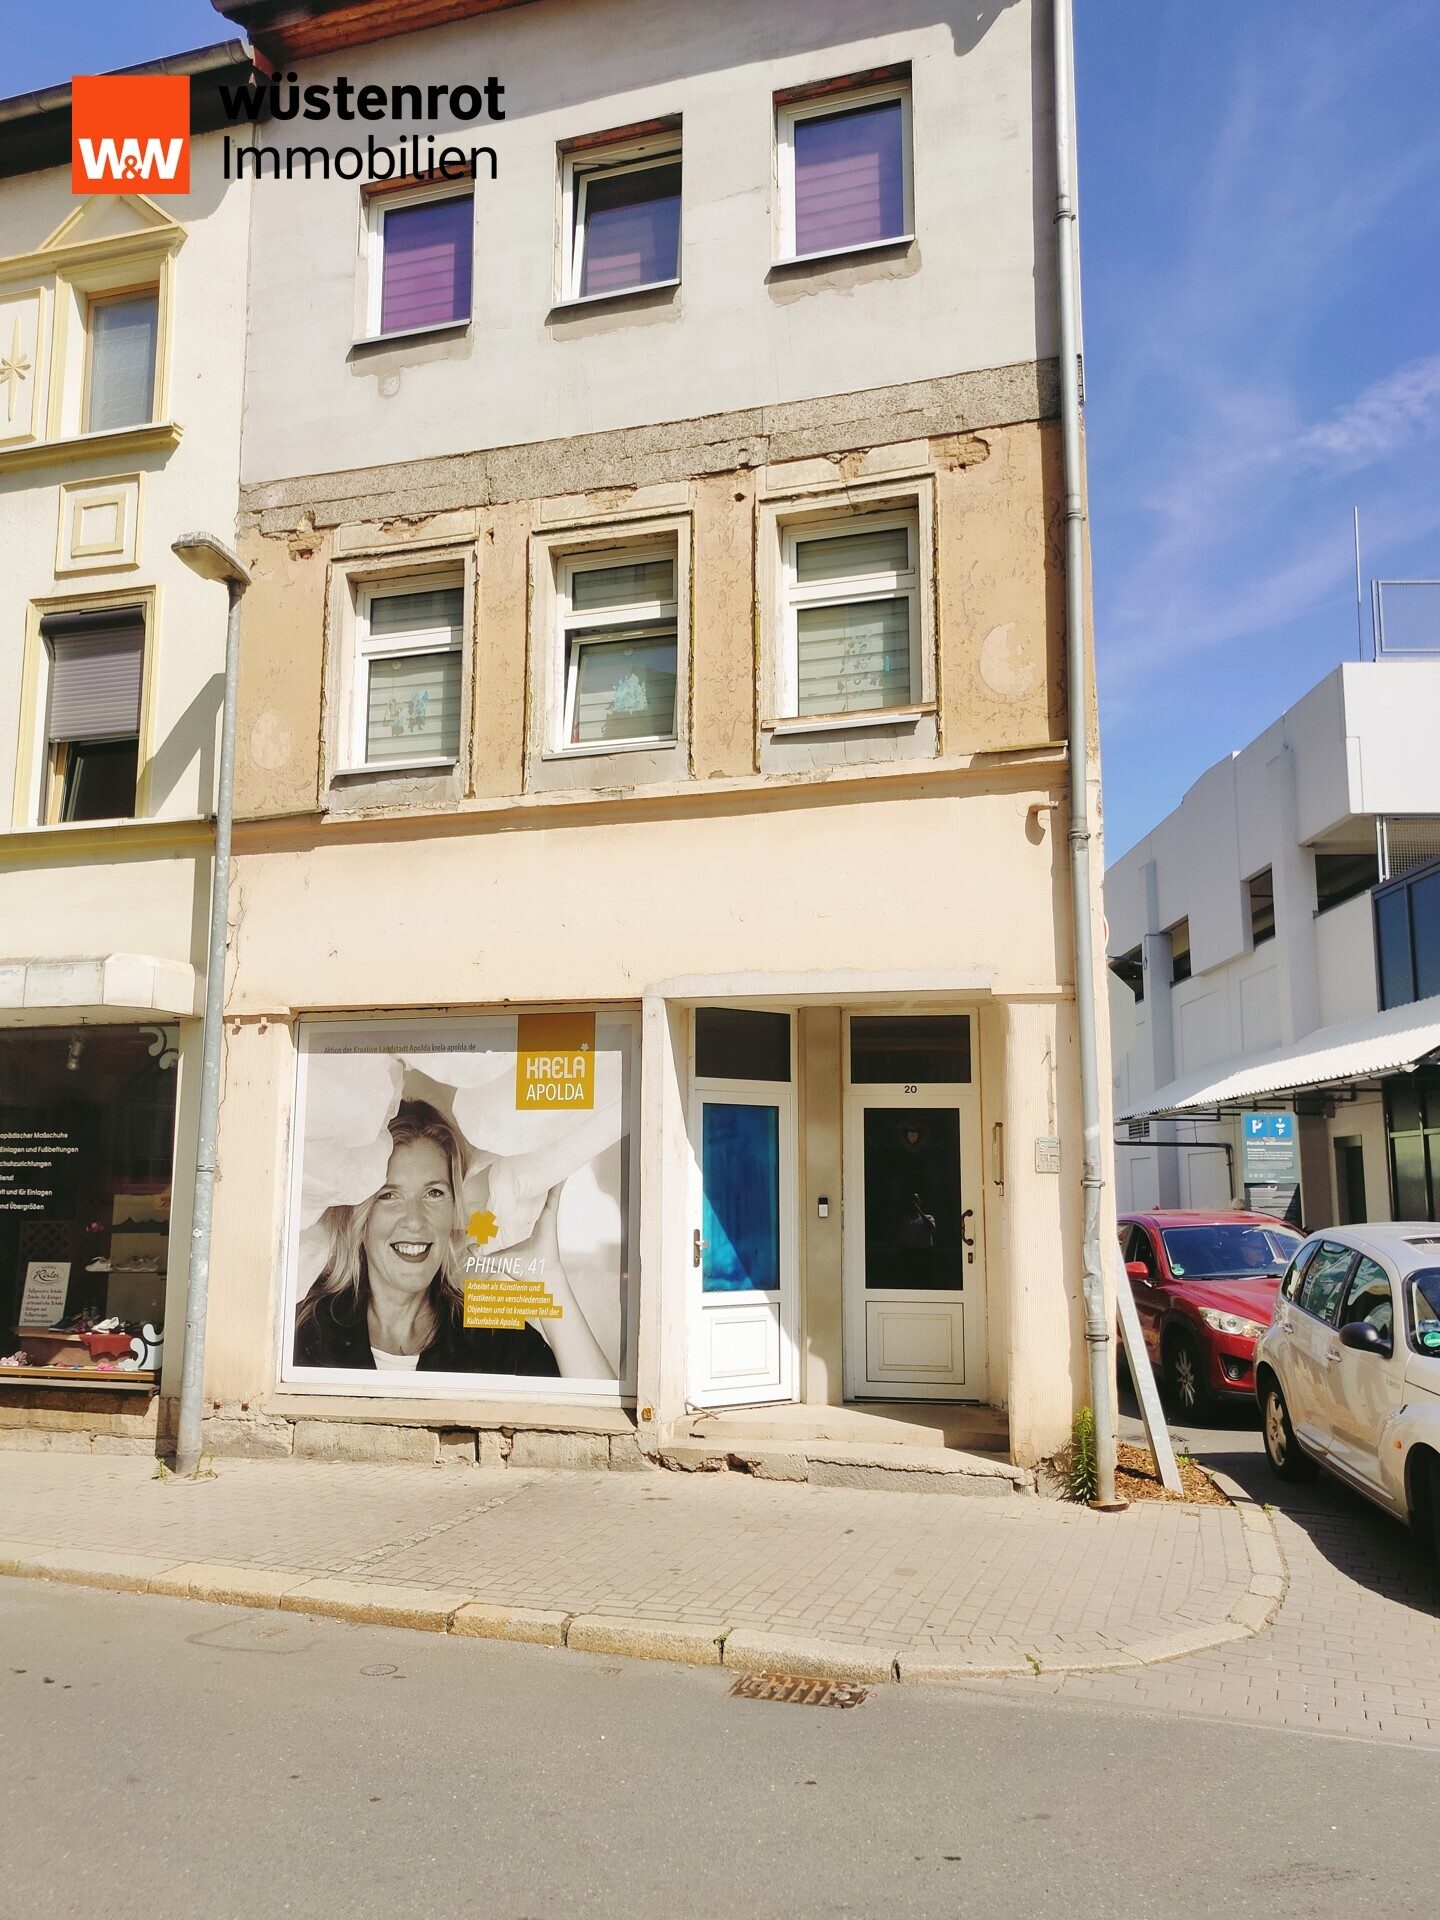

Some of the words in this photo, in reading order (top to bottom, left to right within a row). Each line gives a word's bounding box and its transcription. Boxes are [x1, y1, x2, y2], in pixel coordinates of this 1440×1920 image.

[324, 1046, 341, 1054] Aktion
[343, 1046, 352, 1054] der
[353, 1045, 378, 1053] Kreative
[409, 1044, 431, 1053] Apolda
[526, 1055, 586, 1079] KRELA
[526, 1083, 585, 1101] APOLDA
[904, 1085, 917, 1094] 20
[465, 1256, 524, 1277] PHILINE,
[528, 1257, 546, 1275] 41
[467, 1282, 490, 1291] Arbeitet
[490, 1282, 499, 1291] als
[499, 1282, 528, 1292] Künstlerin
[528, 1283, 541, 1292] und
[467, 1293, 496, 1302] Plastikerin
[505, 1294, 551, 1304] verschiedensten
[467, 1305, 493, 1315] Objekten
[493, 1306, 505, 1314] und
[513, 1307, 538, 1316] kreativer
[538, 1307, 548, 1316] Teil
[549, 1308, 559, 1316] der
[466, 1316, 499, 1326] Kulturfabrik
